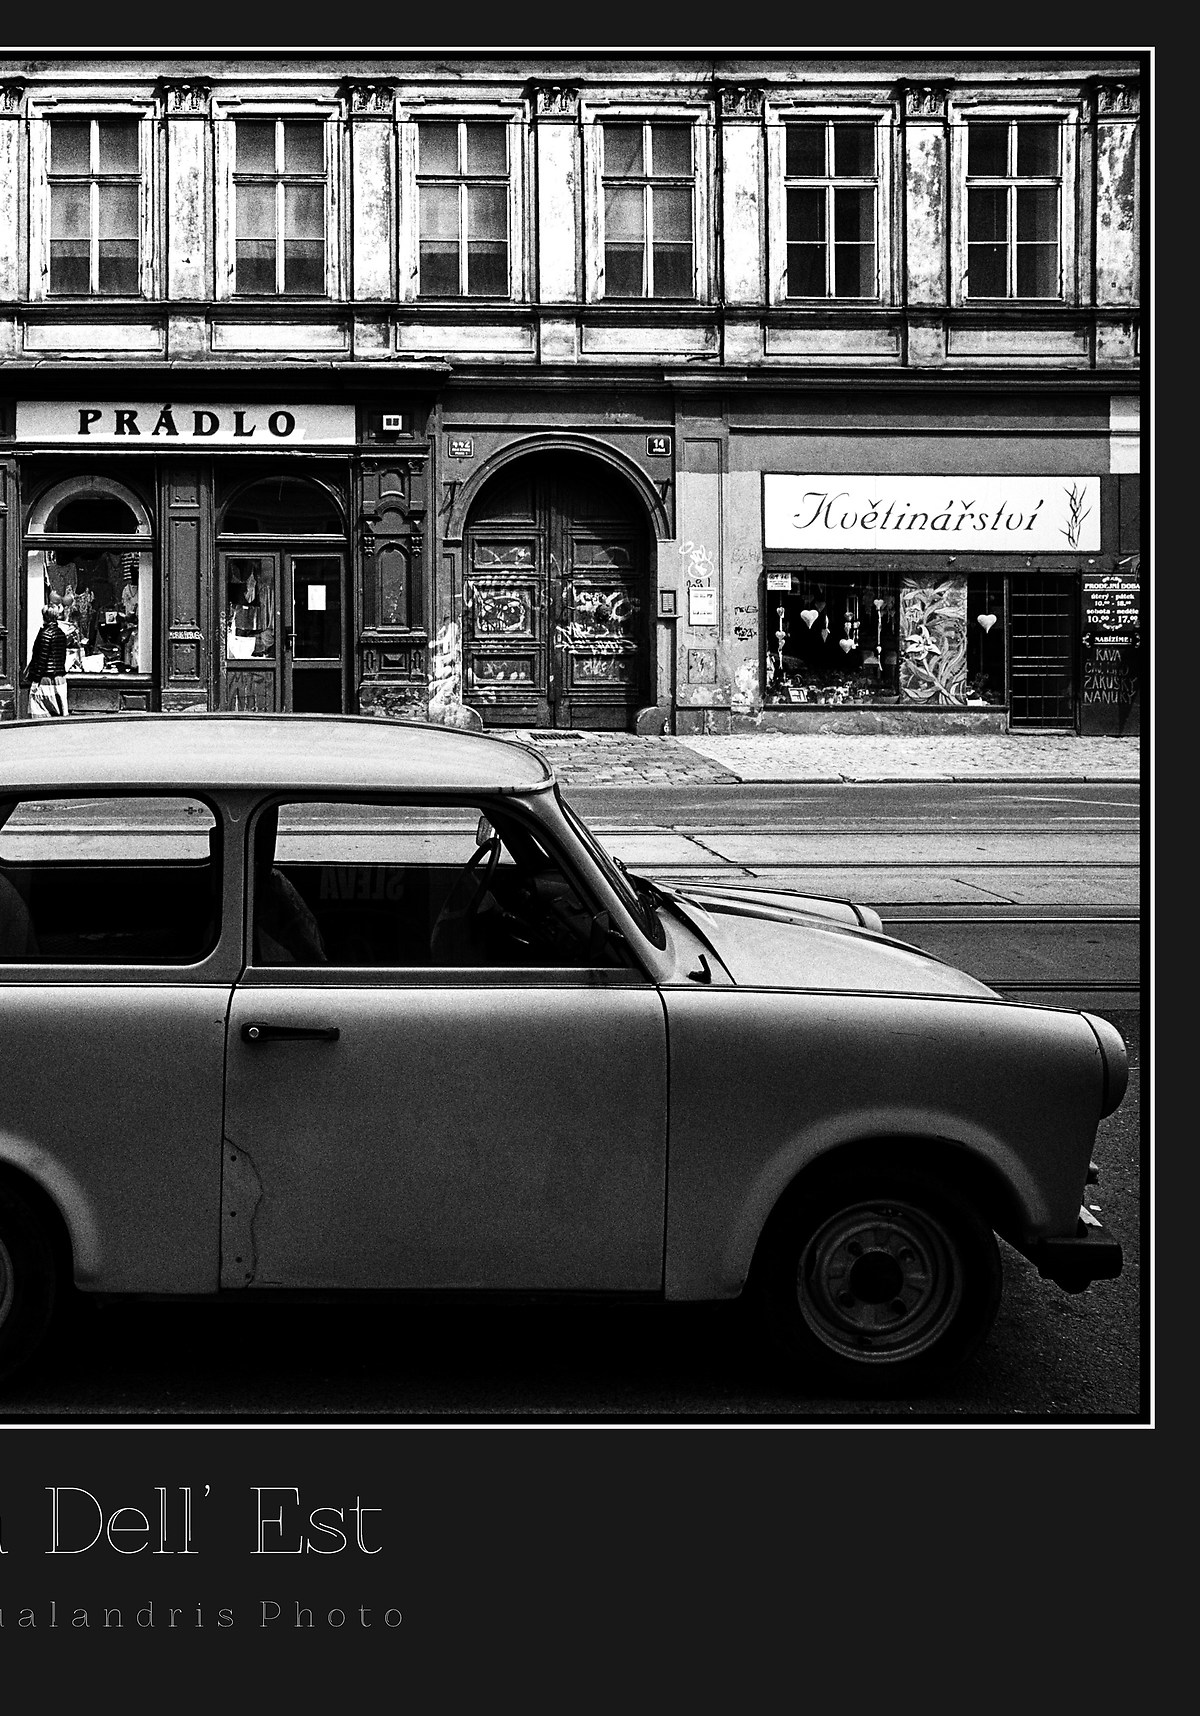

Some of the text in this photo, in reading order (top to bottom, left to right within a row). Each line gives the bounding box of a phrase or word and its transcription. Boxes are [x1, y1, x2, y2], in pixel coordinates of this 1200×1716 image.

[78, 404, 296, 437] PRÁDLO
[653, 438, 665, 448] 14
[792, 492, 1044, 531] Květinářství
